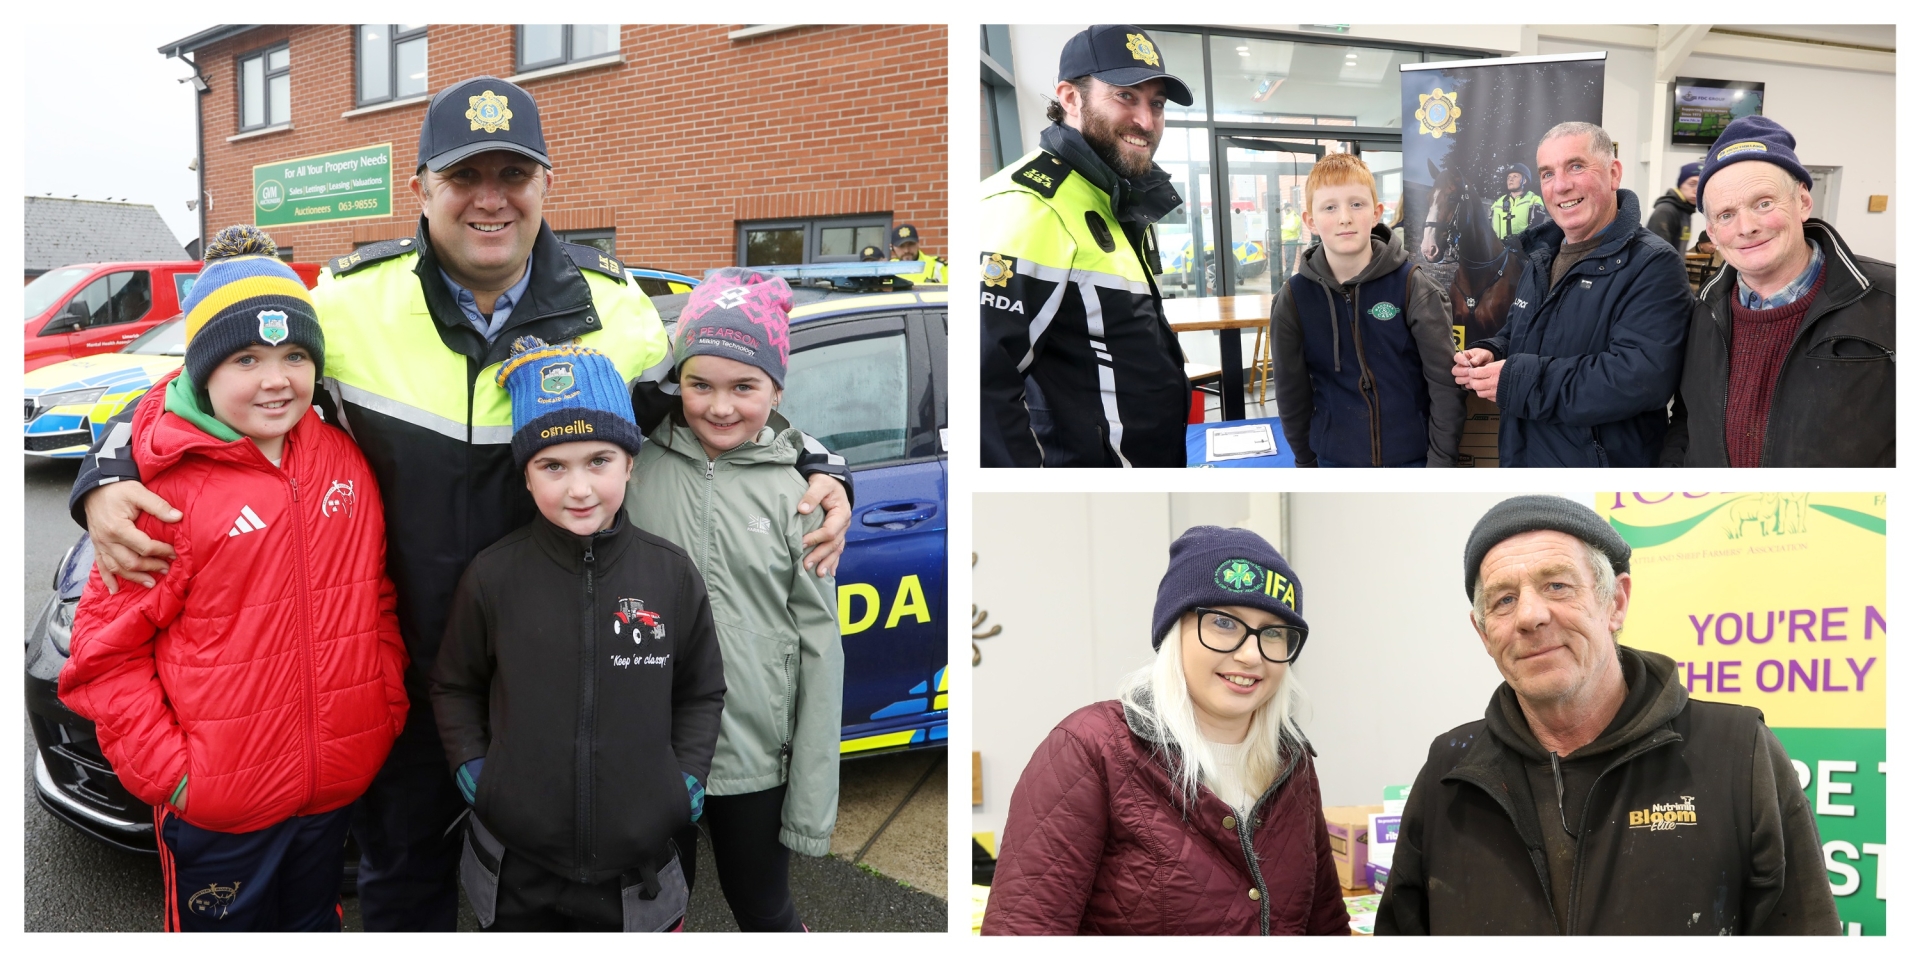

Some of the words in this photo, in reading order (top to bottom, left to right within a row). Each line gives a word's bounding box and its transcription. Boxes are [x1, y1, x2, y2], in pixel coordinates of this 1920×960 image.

[284, 168, 295, 179] For
[296, 166, 306, 177] All
[307, 164, 323, 175] Your
[325, 159, 358, 173] Property
[360, 153, 388, 168] Needs
[262, 186, 278, 199] GVM
[289, 187, 303, 196] Sales
[305, 184, 326, 194] Lettings
[328, 180, 351, 191] Leasing
[352, 177, 383, 188] Valuations
[294, 205, 331, 216] Auctioneers
[338, 198, 378, 212] 063-98555
[980, 291, 1025, 315] RDA
[699, 327, 761, 348] PEARSON
[699, 338, 720, 346] Milking
[721, 340, 756, 356] Technology
[1676, 551, 1700, 561] SHEEP
[1747, 543, 1808, 555] ASSOCIATION
[1264, 569, 1296, 612] IFA
[838, 574, 931, 636] DA
[1688, 607, 1848, 646] YOU'RE
[1756, 657, 1877, 693] ONLY
[1629, 809, 1697, 826] Bloom
[1652, 803, 1696, 813] Nutrimin
[1650, 818, 1677, 832] Elite
